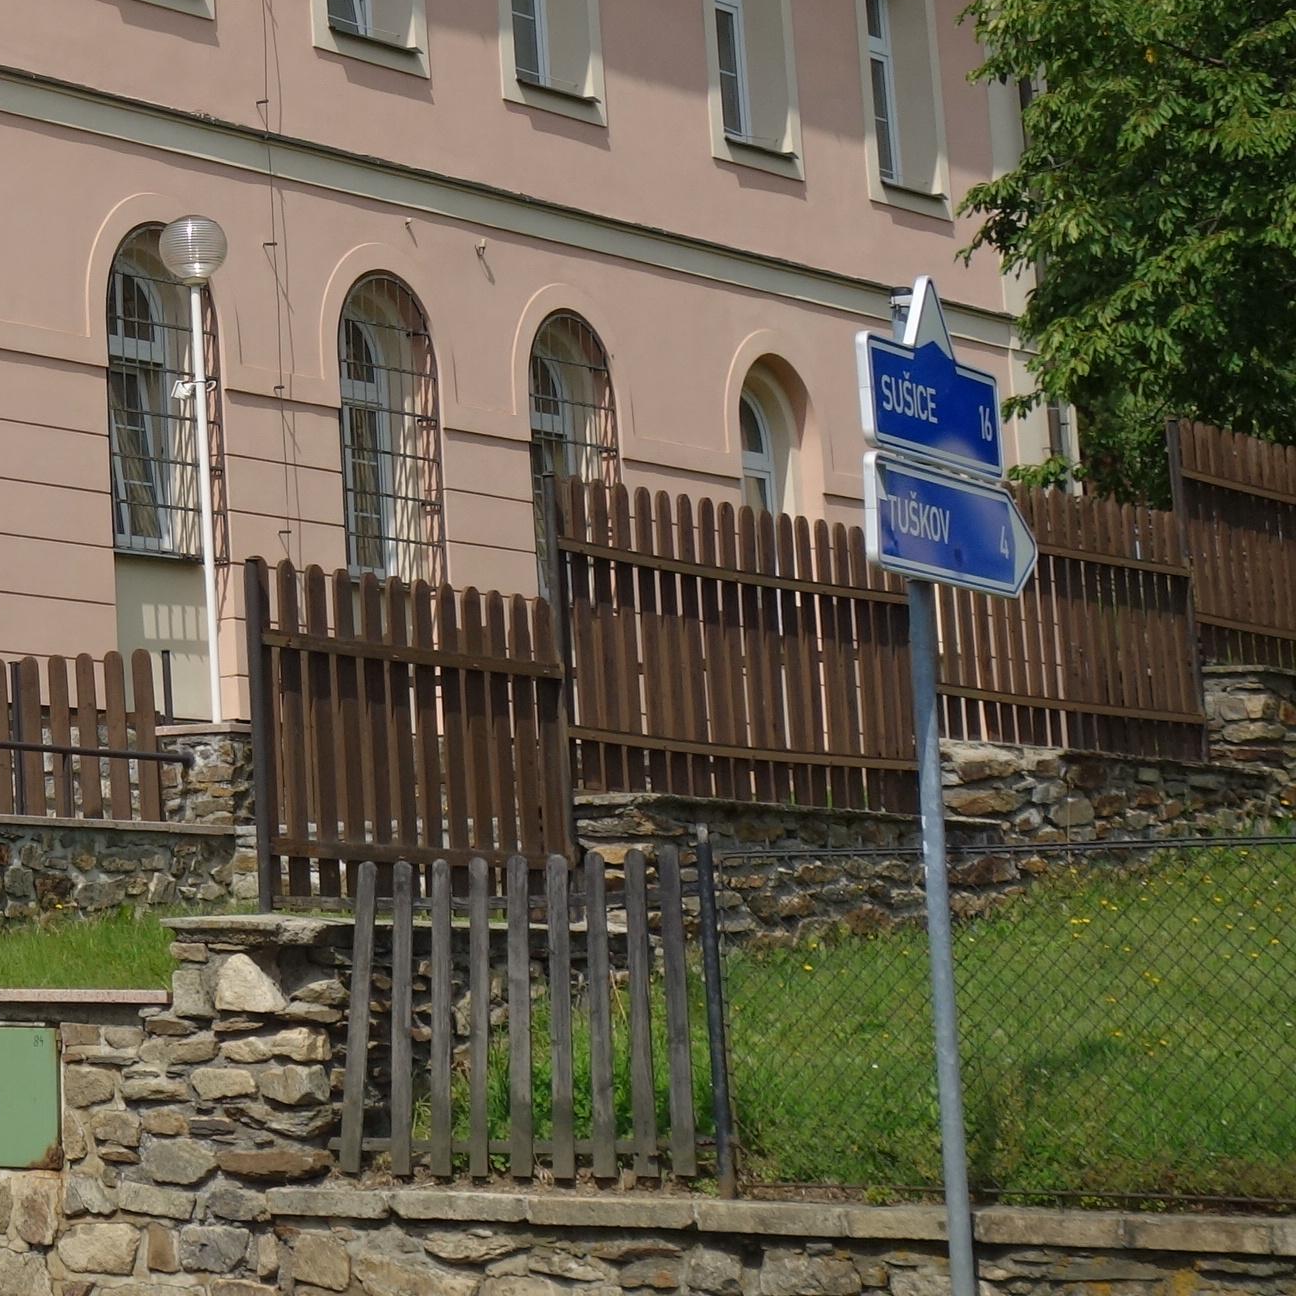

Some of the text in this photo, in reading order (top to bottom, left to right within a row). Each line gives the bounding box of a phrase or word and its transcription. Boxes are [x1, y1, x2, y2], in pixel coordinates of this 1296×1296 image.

[880, 370, 993, 442] SUŠICE 16
[888, 490, 1010, 560] TUŠKOV 4
